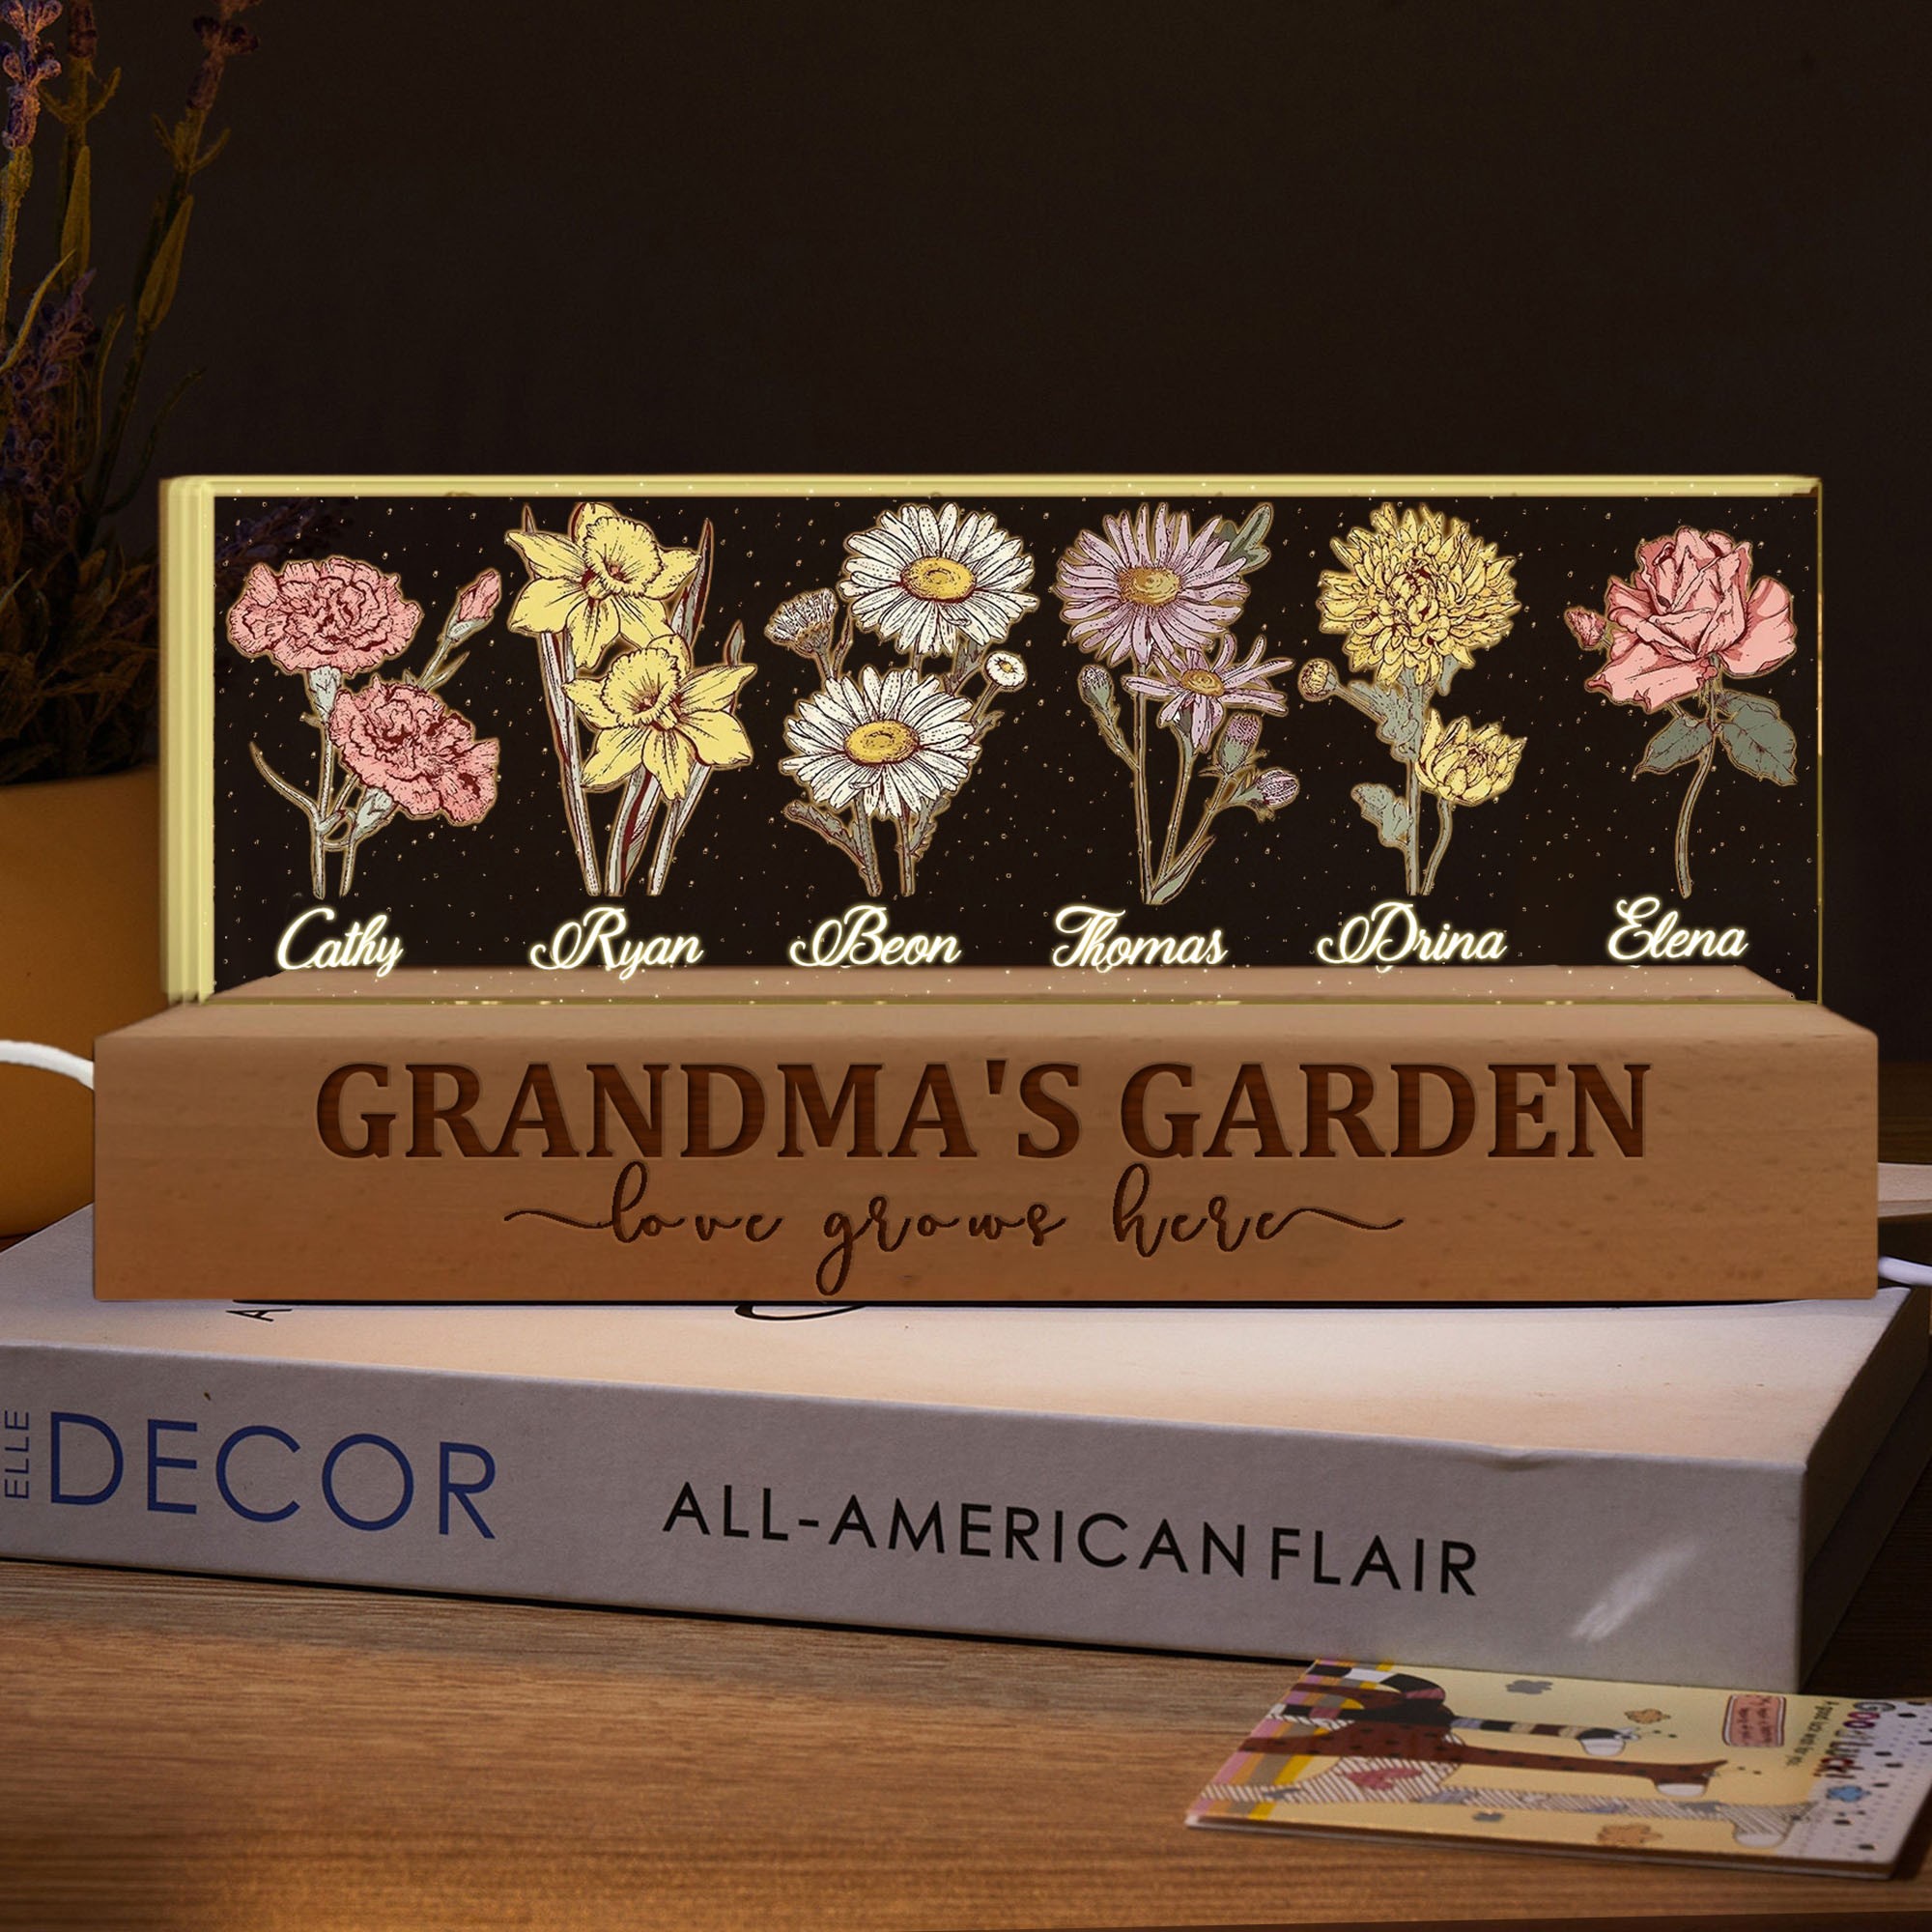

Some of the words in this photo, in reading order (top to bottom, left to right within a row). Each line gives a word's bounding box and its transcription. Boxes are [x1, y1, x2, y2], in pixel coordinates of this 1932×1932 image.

[276, 906, 405, 977] Cathy
[529, 905, 704, 980] Ryan
[789, 904, 961, 968] Beon
[1052, 905, 1228, 971] Thomas
[1317, 900, 1508, 972] Drina
[1607, 895, 1749, 962] Elena
[316, 1059, 1082, 1160] GRANDMA'S
[1121, 1062, 1650, 1159] GARDEN
[503, 1160, 784, 1244] love
[815, 1196, 1066, 1297] grows
[1113, 1163, 1405, 1259] here
[4, 1409, 30, 1499] ELLE
[50, 1411, 497, 1540] DECOR
[663, 1481, 1248, 1578] ALL-AMERICAN
[1269, 1528, 1479, 1596] FLAIR
